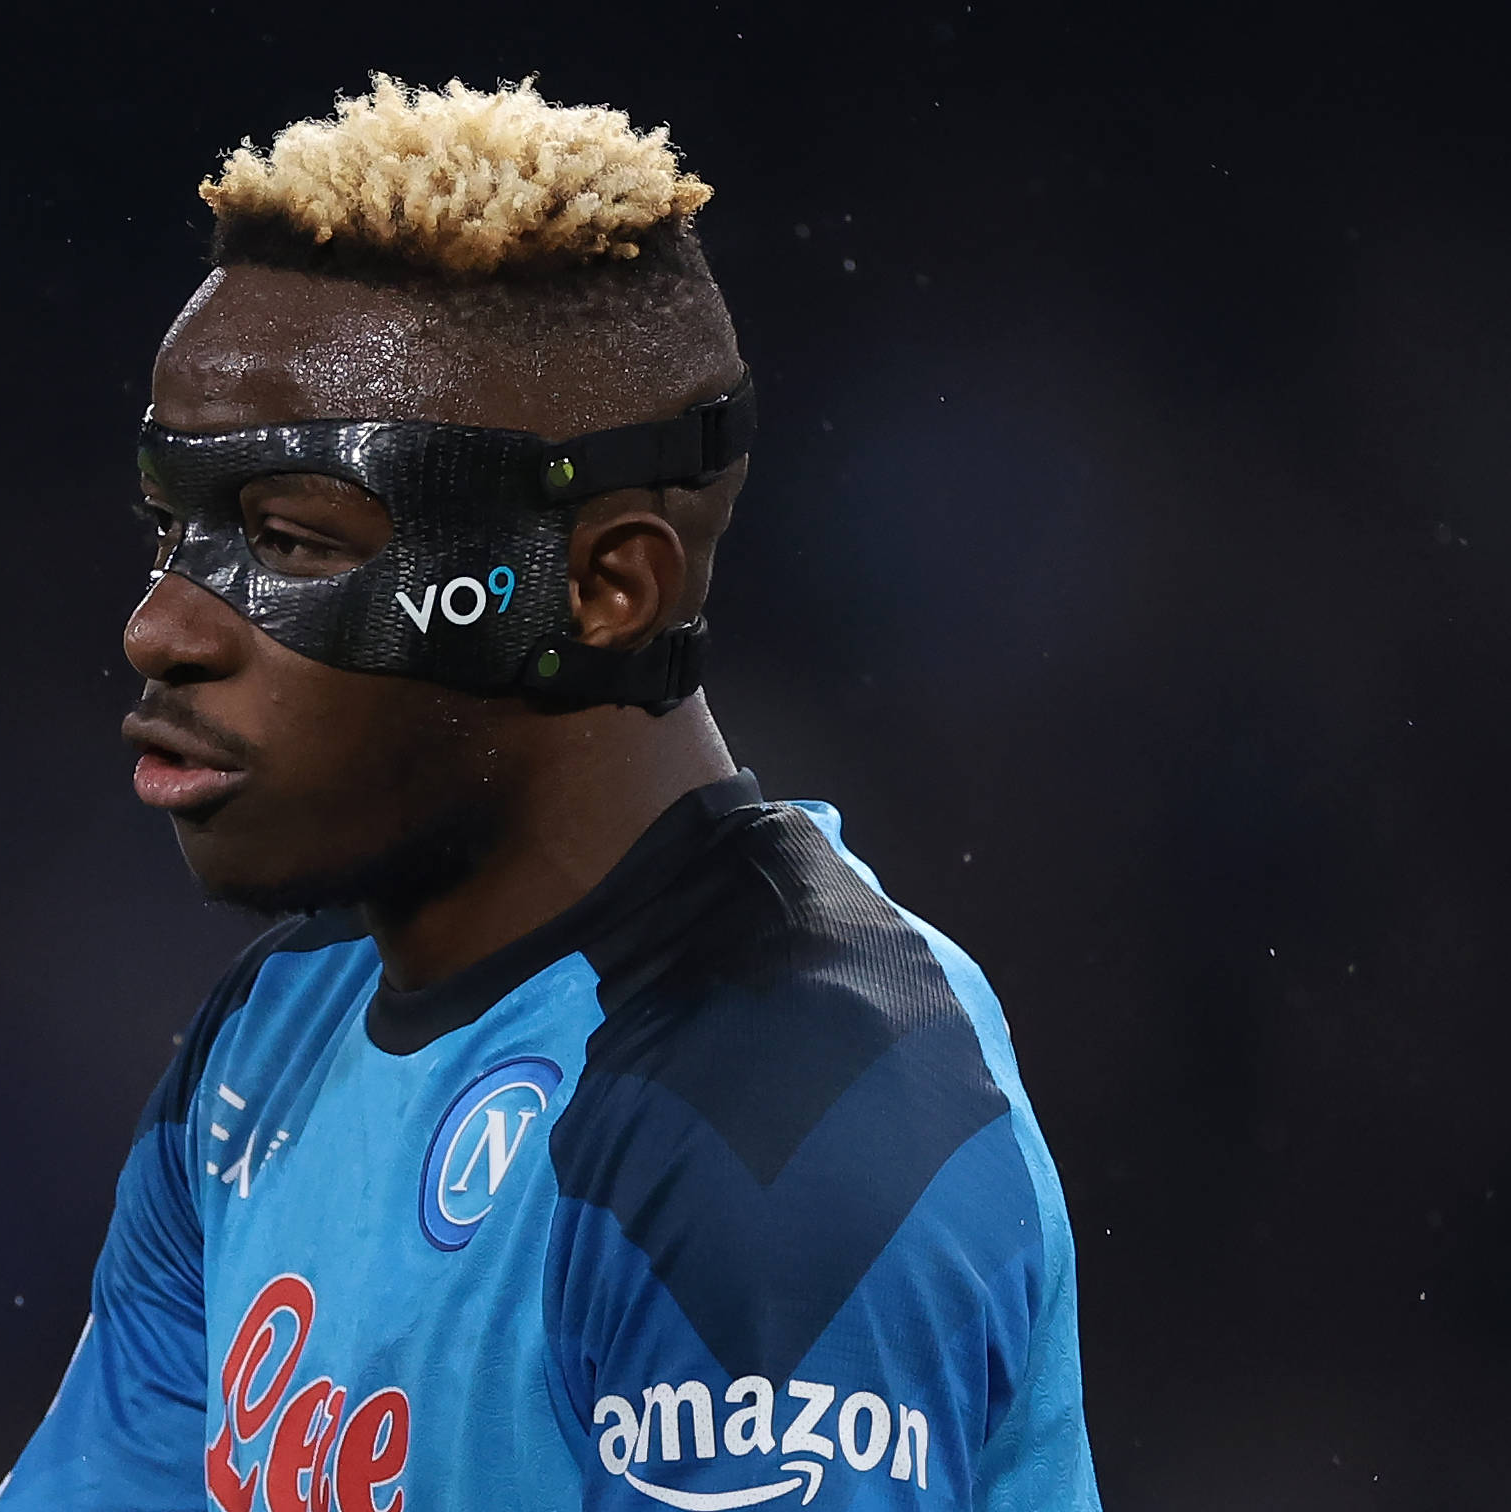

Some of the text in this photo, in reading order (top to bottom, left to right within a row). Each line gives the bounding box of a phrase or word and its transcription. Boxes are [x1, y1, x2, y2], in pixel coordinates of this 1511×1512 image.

[394, 565, 515, 634] VO9
[450, 1108, 536, 1196] N
[593, 1374, 929, 1491] amazon
